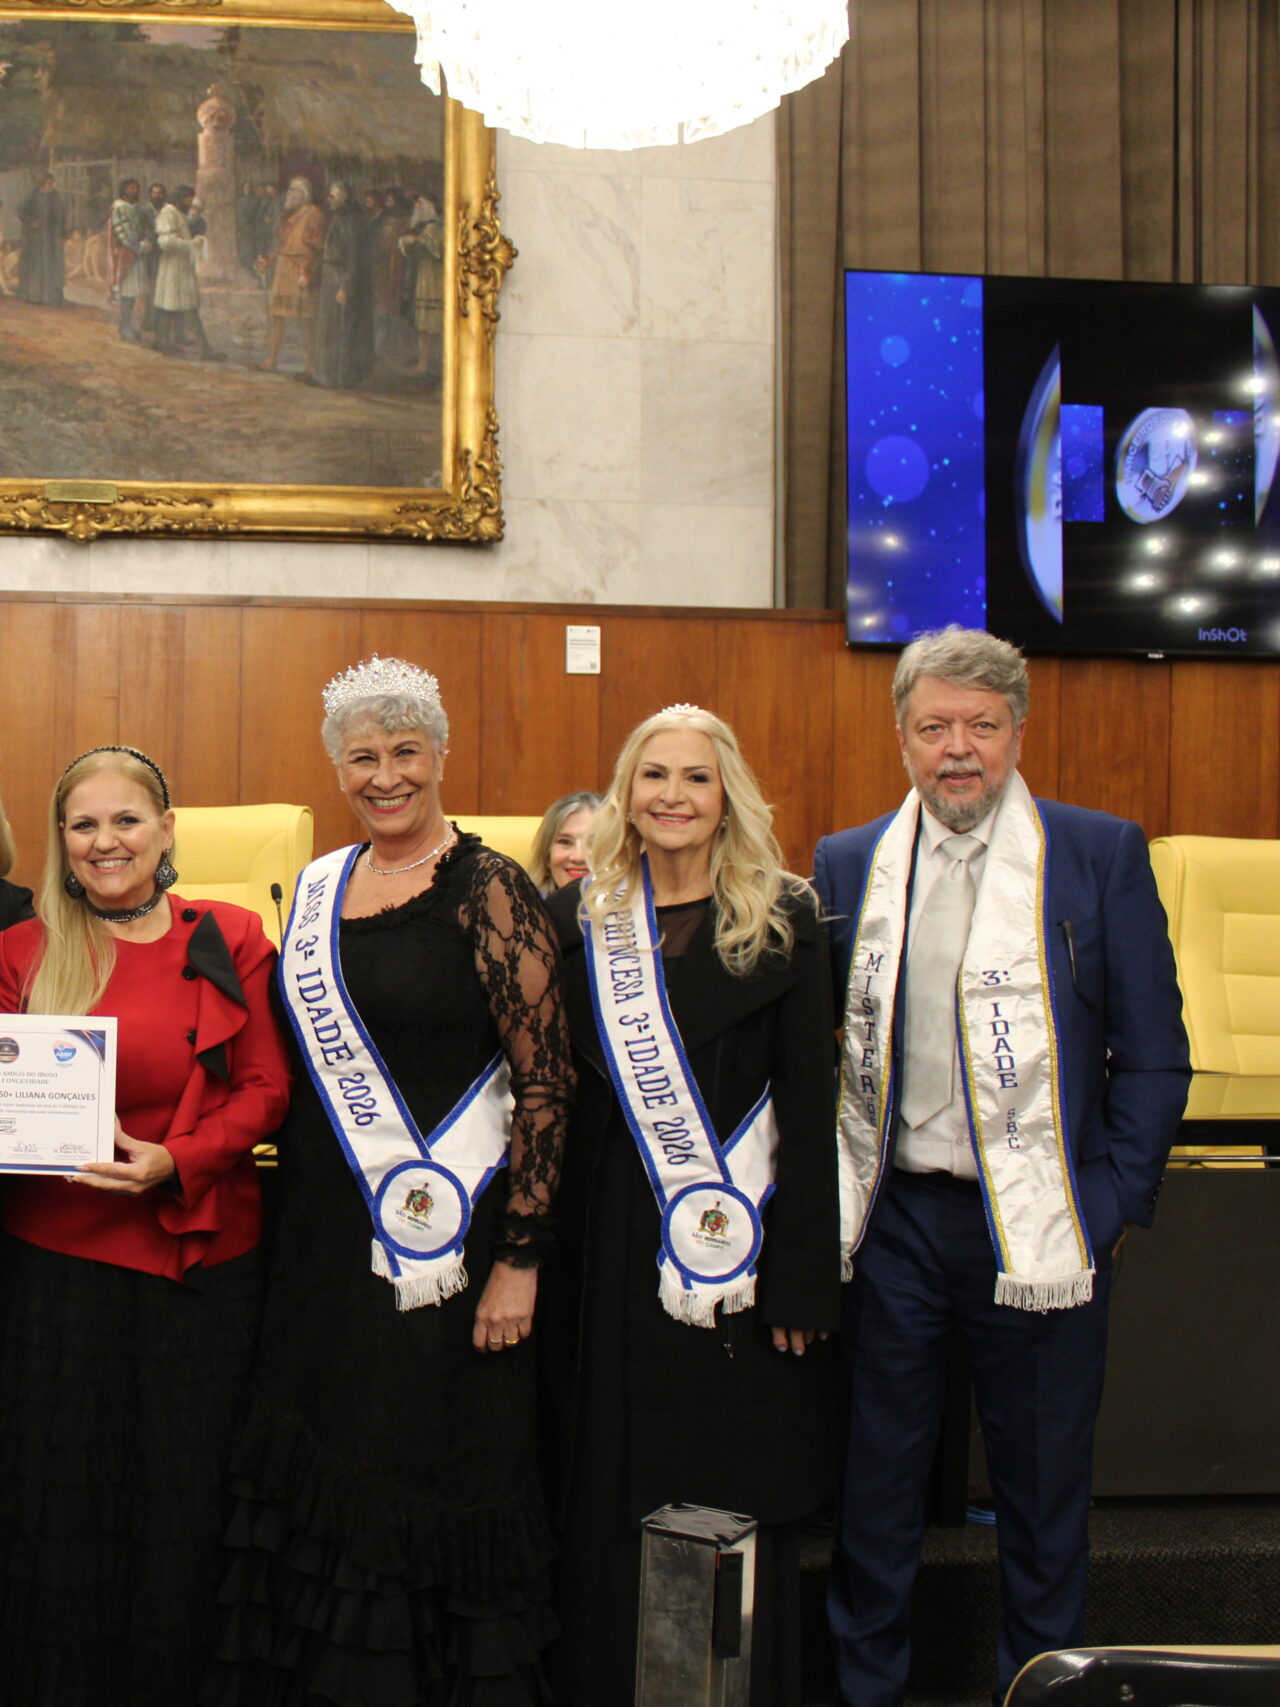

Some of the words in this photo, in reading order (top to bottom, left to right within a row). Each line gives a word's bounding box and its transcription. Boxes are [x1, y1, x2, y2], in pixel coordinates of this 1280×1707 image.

[298, 873, 329, 930] MISS
[296, 967, 356, 1066] IDADE
[860, 952, 884, 1095] MISTER
[990, 1002, 1019, 1090] IDADE
[1, 1077, 50, 1085] LONGEVIDADE
[15, 1091, 46, 1099] LILIANA
[48, 1092, 96, 1101] GONÇALVES
[337, 1072, 382, 1127] 2026
[624, 1035, 678, 1110] IDADE
[652, 1116, 699, 1165] 2026
